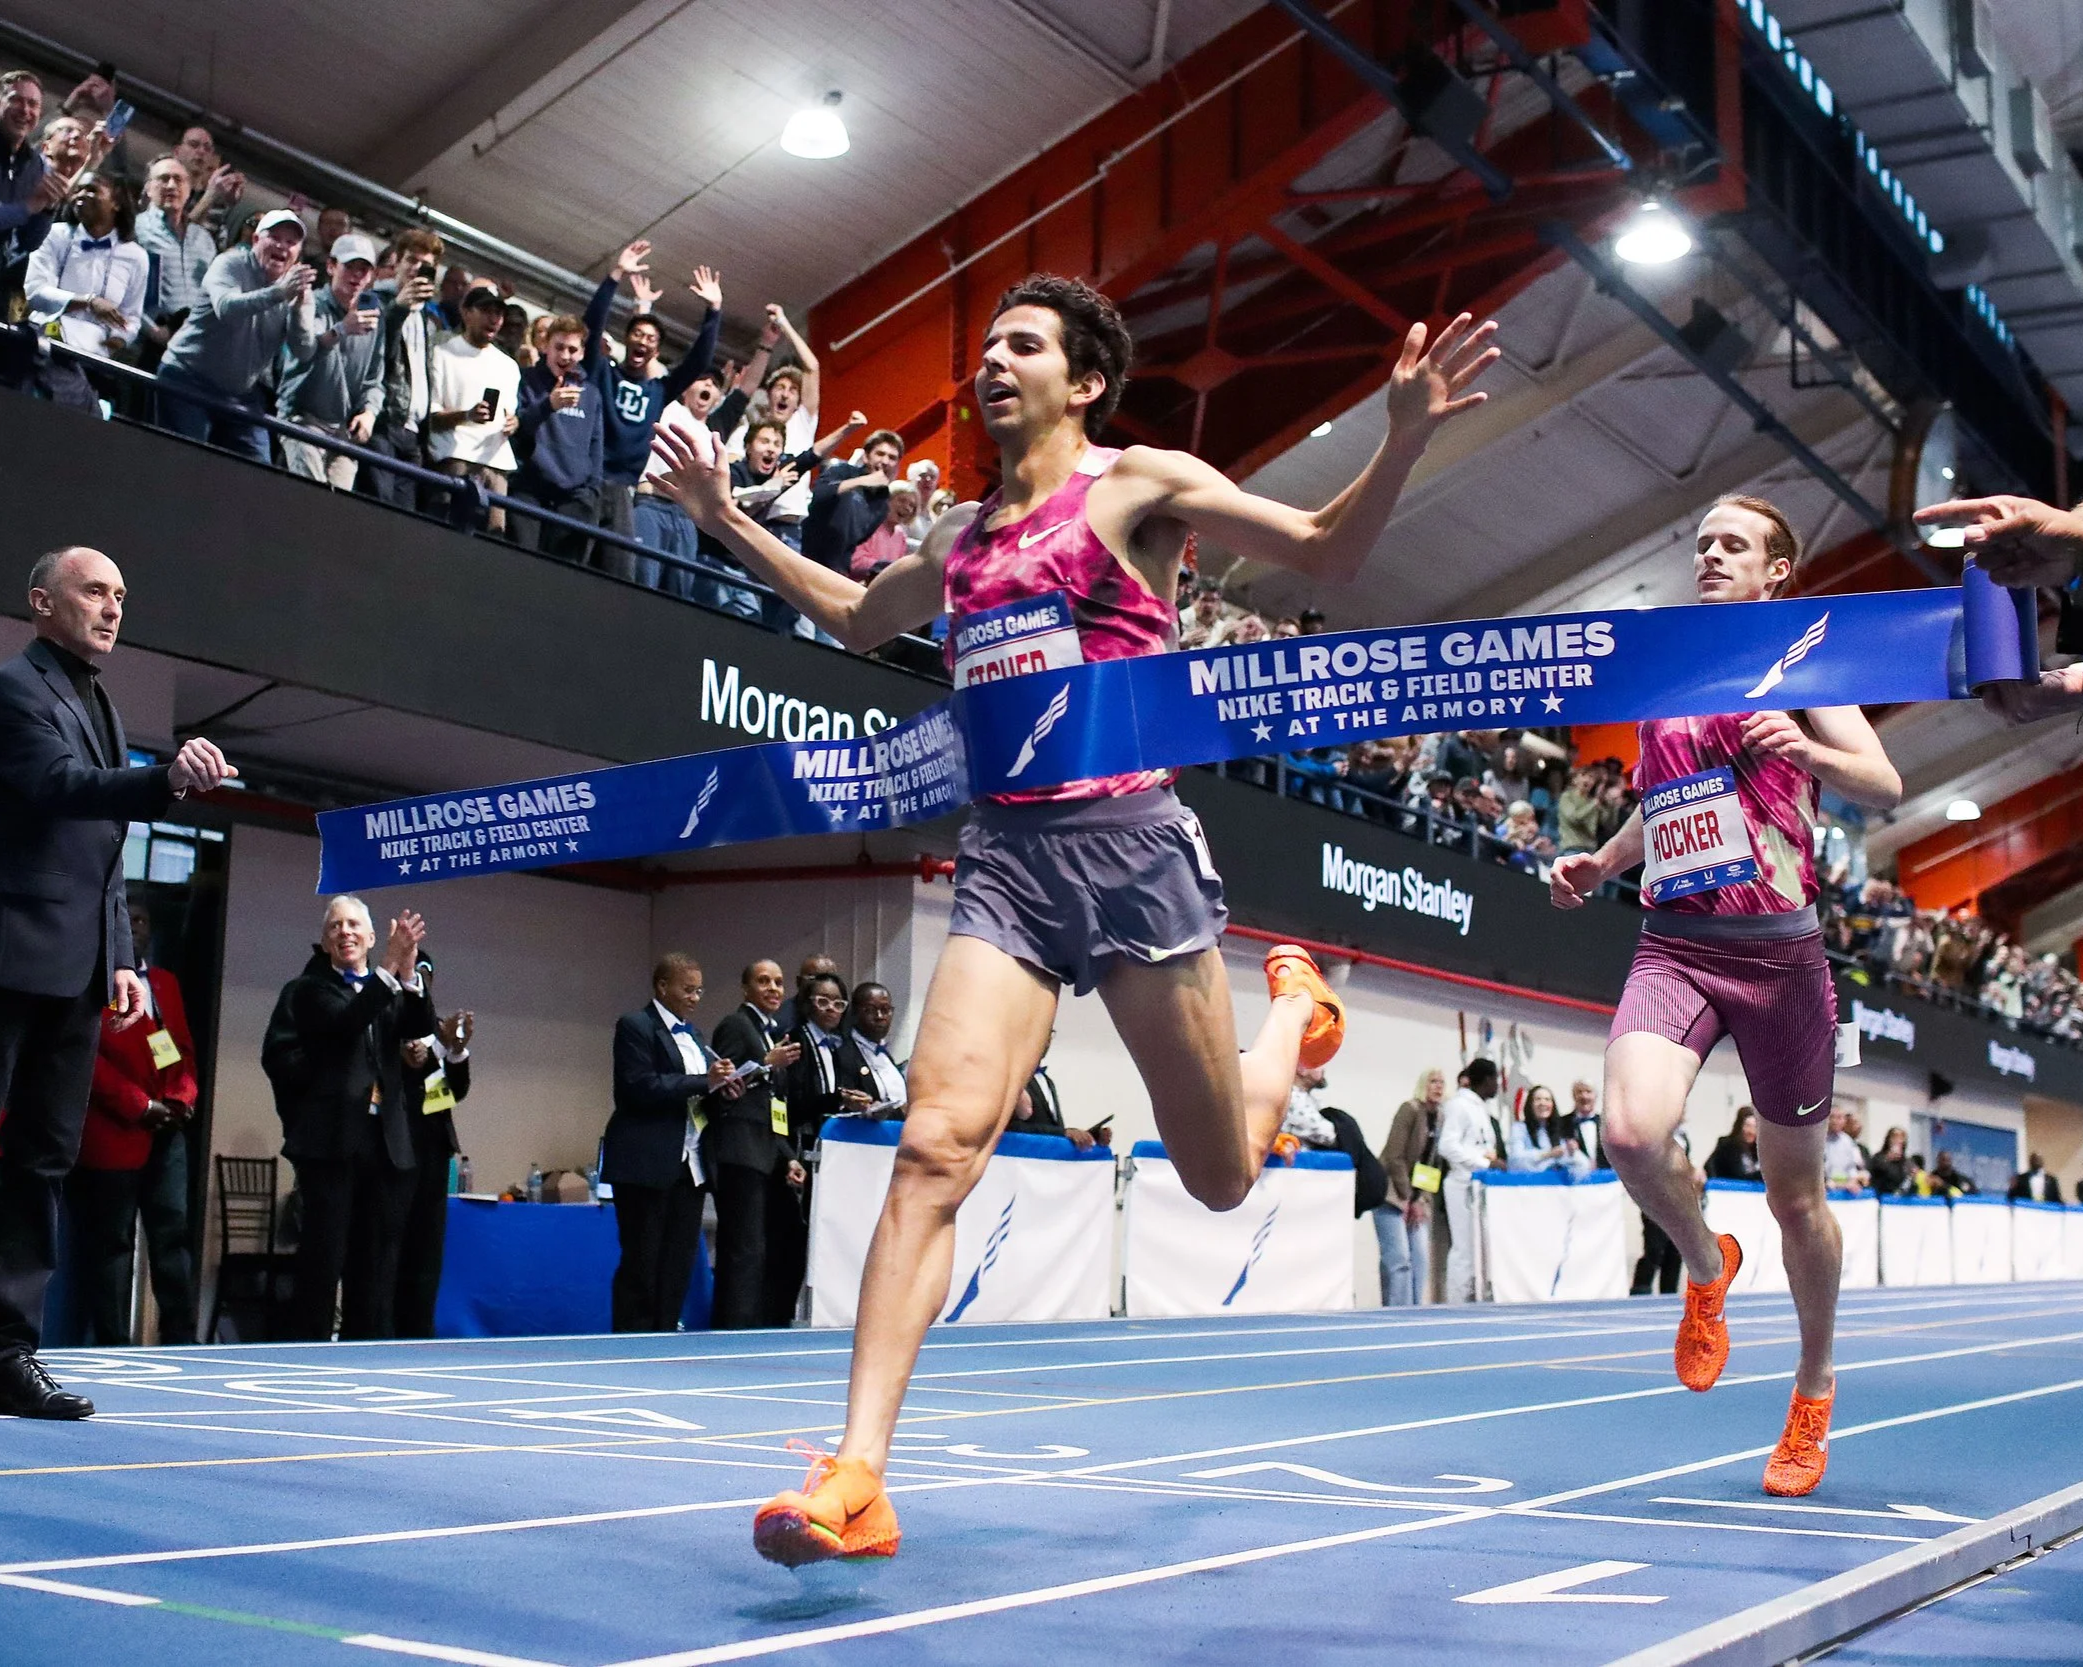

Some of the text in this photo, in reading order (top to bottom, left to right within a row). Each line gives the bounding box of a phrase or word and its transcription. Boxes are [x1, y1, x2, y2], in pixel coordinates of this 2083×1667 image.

[1005, 606, 1060, 635] GAMES
[1189, 621, 1615, 696] MILLROSE GAMES
[1217, 664, 1593, 722] NIKE TRACK & FIELD CENTER
[1288, 697, 1527, 736] AT THE ARMORY
[793, 729, 922, 779] MILLROSE
[808, 782, 860, 802] NIKE
[863, 771, 911, 799] TRACK
[911, 770, 920, 788] &
[919, 759, 942, 786] FIELD
[1681, 777, 1725, 800] GAMES
[365, 781, 597, 840] MILLROSE GAMES
[857, 804, 882, 820] AT
[891, 796, 918, 817] THE
[380, 815, 590, 860] NIKE TRACK & FIELD CENTER
[420, 841, 559, 873] AT THE ARMORY
[1652, 809, 1724, 864] HOCKER
[1322, 842, 1474, 936] Morgan Stanley
[1178, 1460, 1514, 1494] 2
